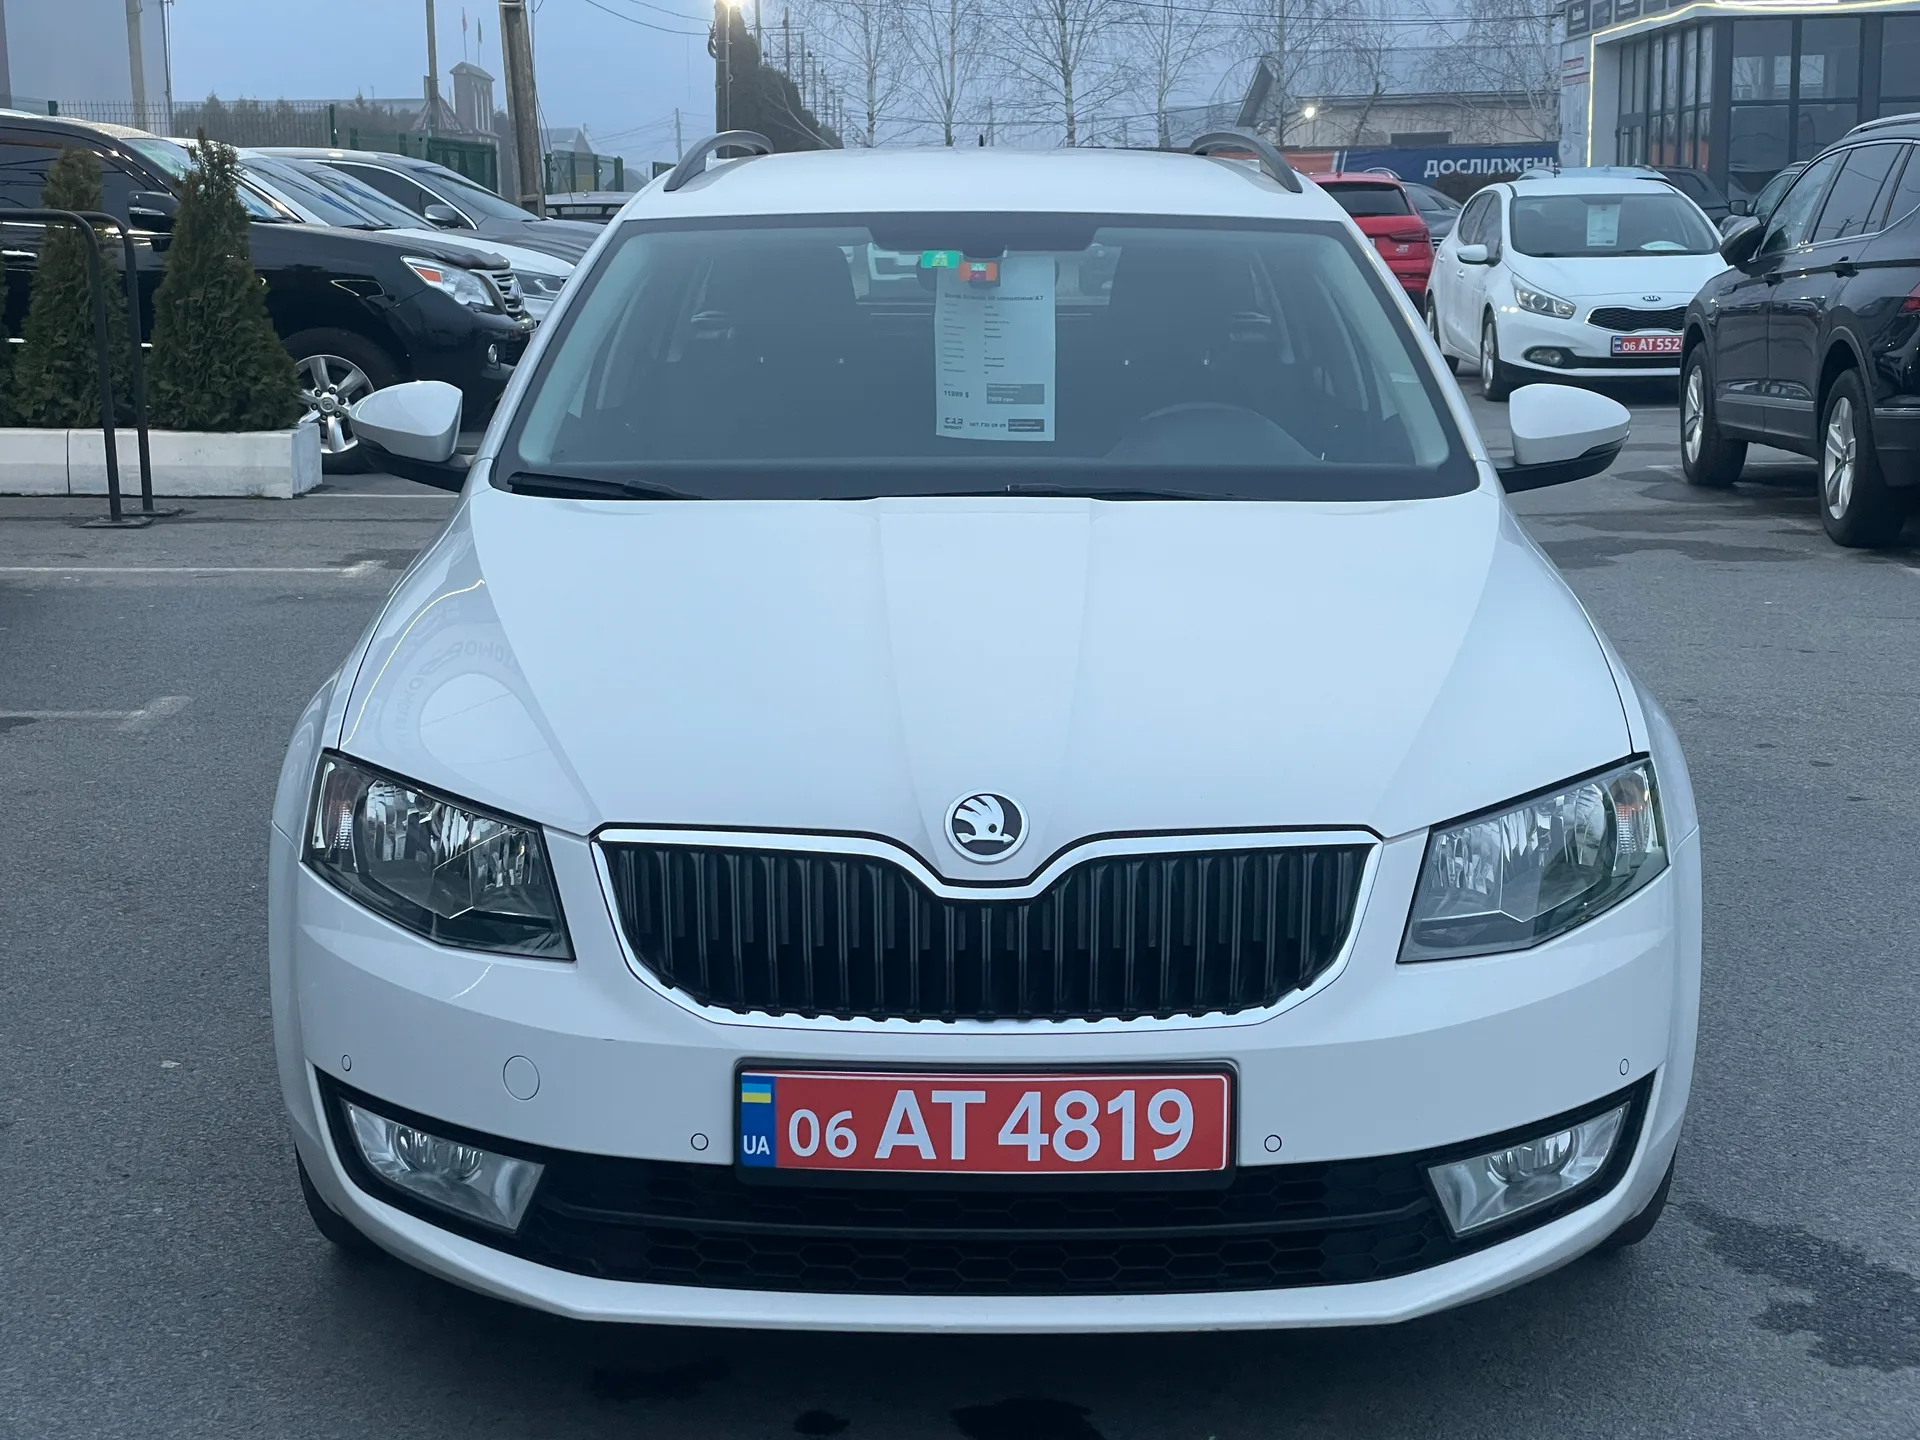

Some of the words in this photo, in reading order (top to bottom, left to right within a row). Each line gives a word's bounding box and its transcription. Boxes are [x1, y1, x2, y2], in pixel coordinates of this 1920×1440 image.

[1623, 342, 1636, 351] 06
[1639, 338, 1655, 351] AT
[788, 1108, 857, 1158] 06
[874, 1089, 986, 1160] AT
[997, 1088, 1195, 1161] 4819
[743, 1134, 770, 1155] UA
